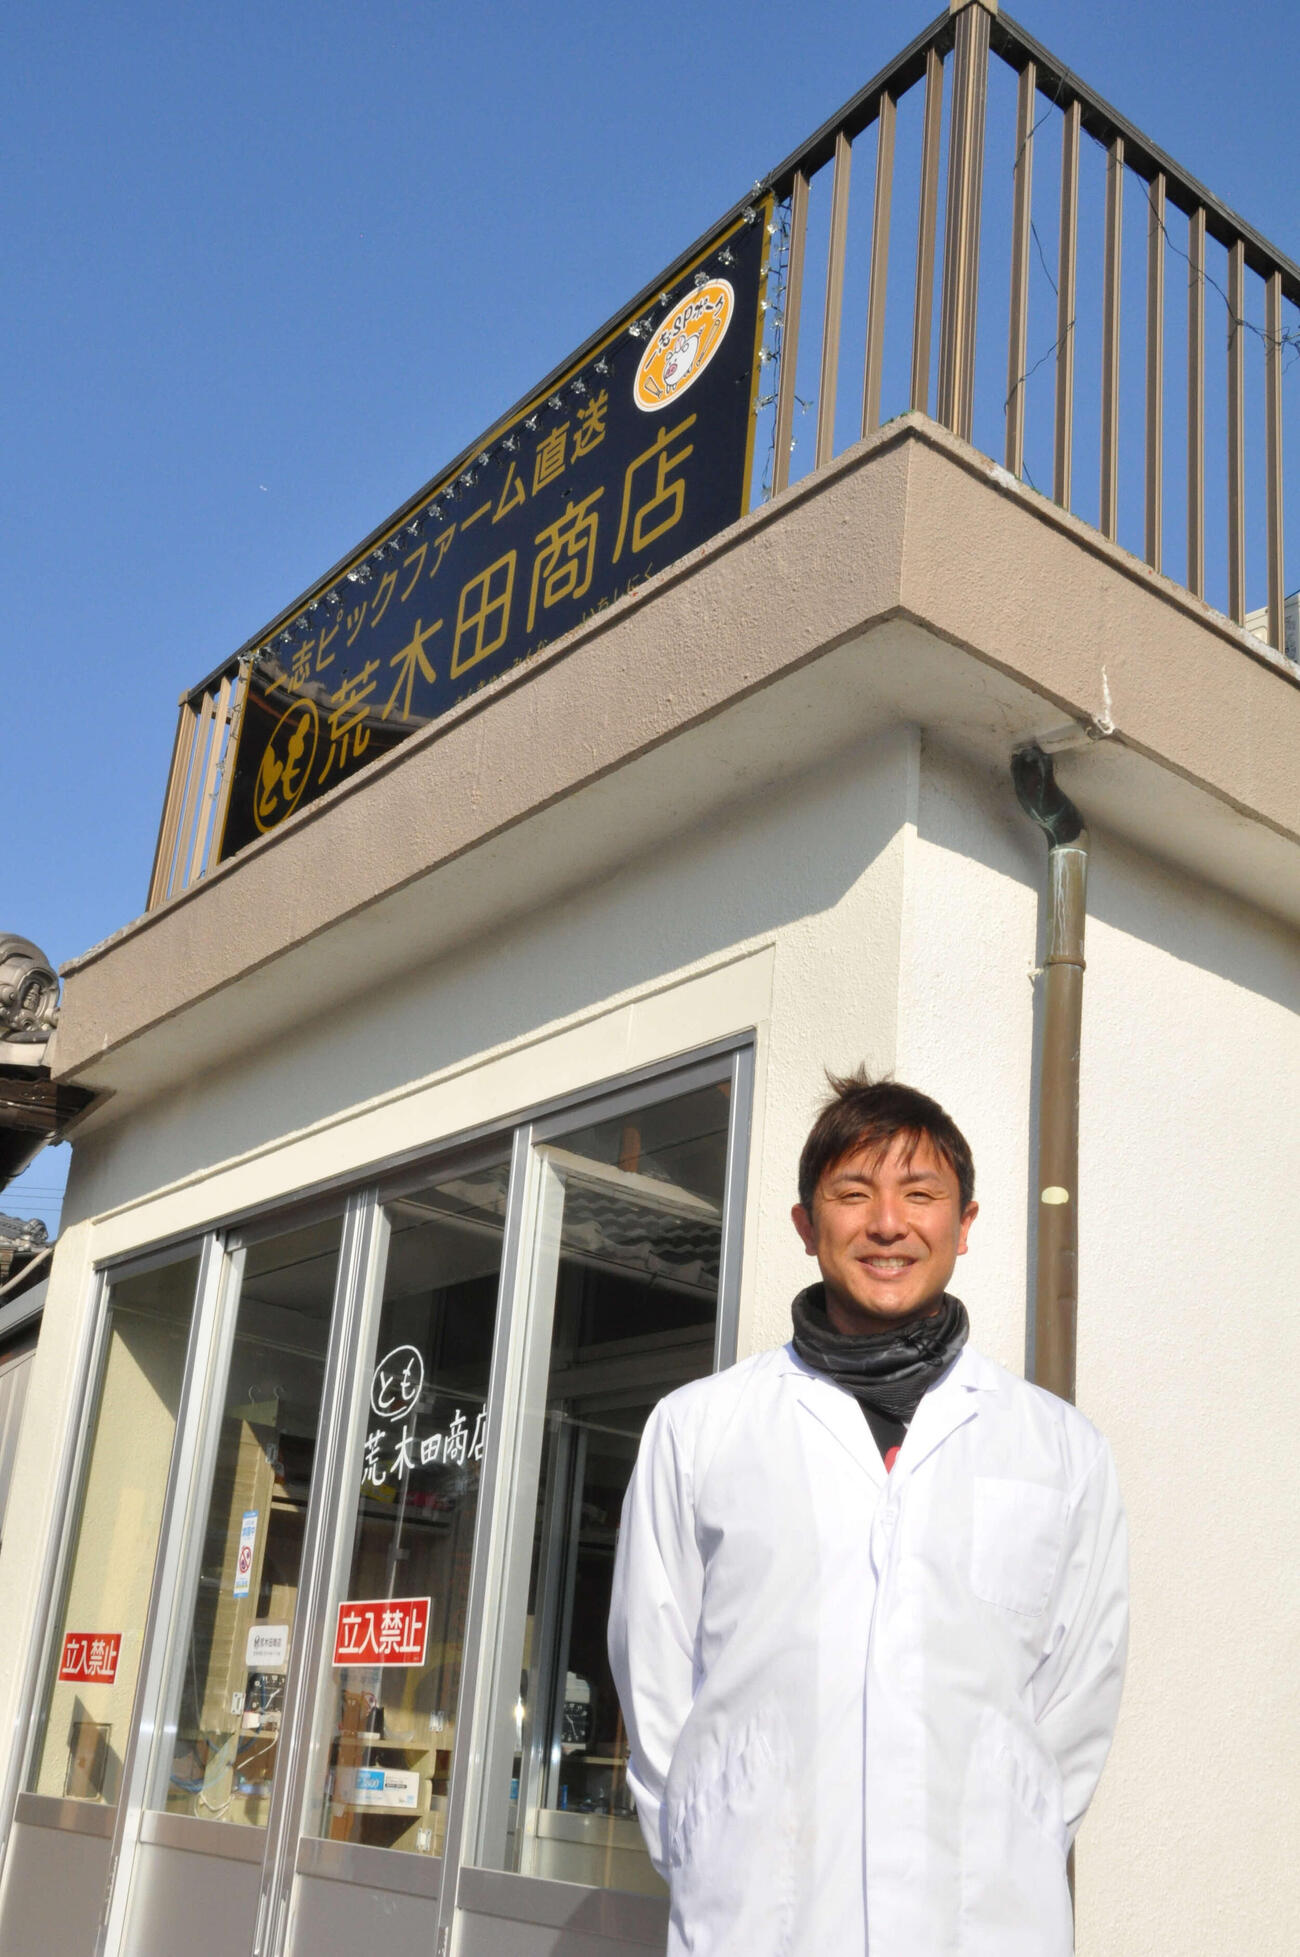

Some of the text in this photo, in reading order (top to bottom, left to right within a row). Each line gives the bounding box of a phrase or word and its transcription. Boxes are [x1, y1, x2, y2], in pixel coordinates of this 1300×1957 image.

[264, 389, 609, 697] 一志ピックファーム直送
[318, 413, 698, 785] 荒木田商店
[61, 1638, 118, 1677] 立入禁止
[337, 1608, 423, 1655] 立入禁止
